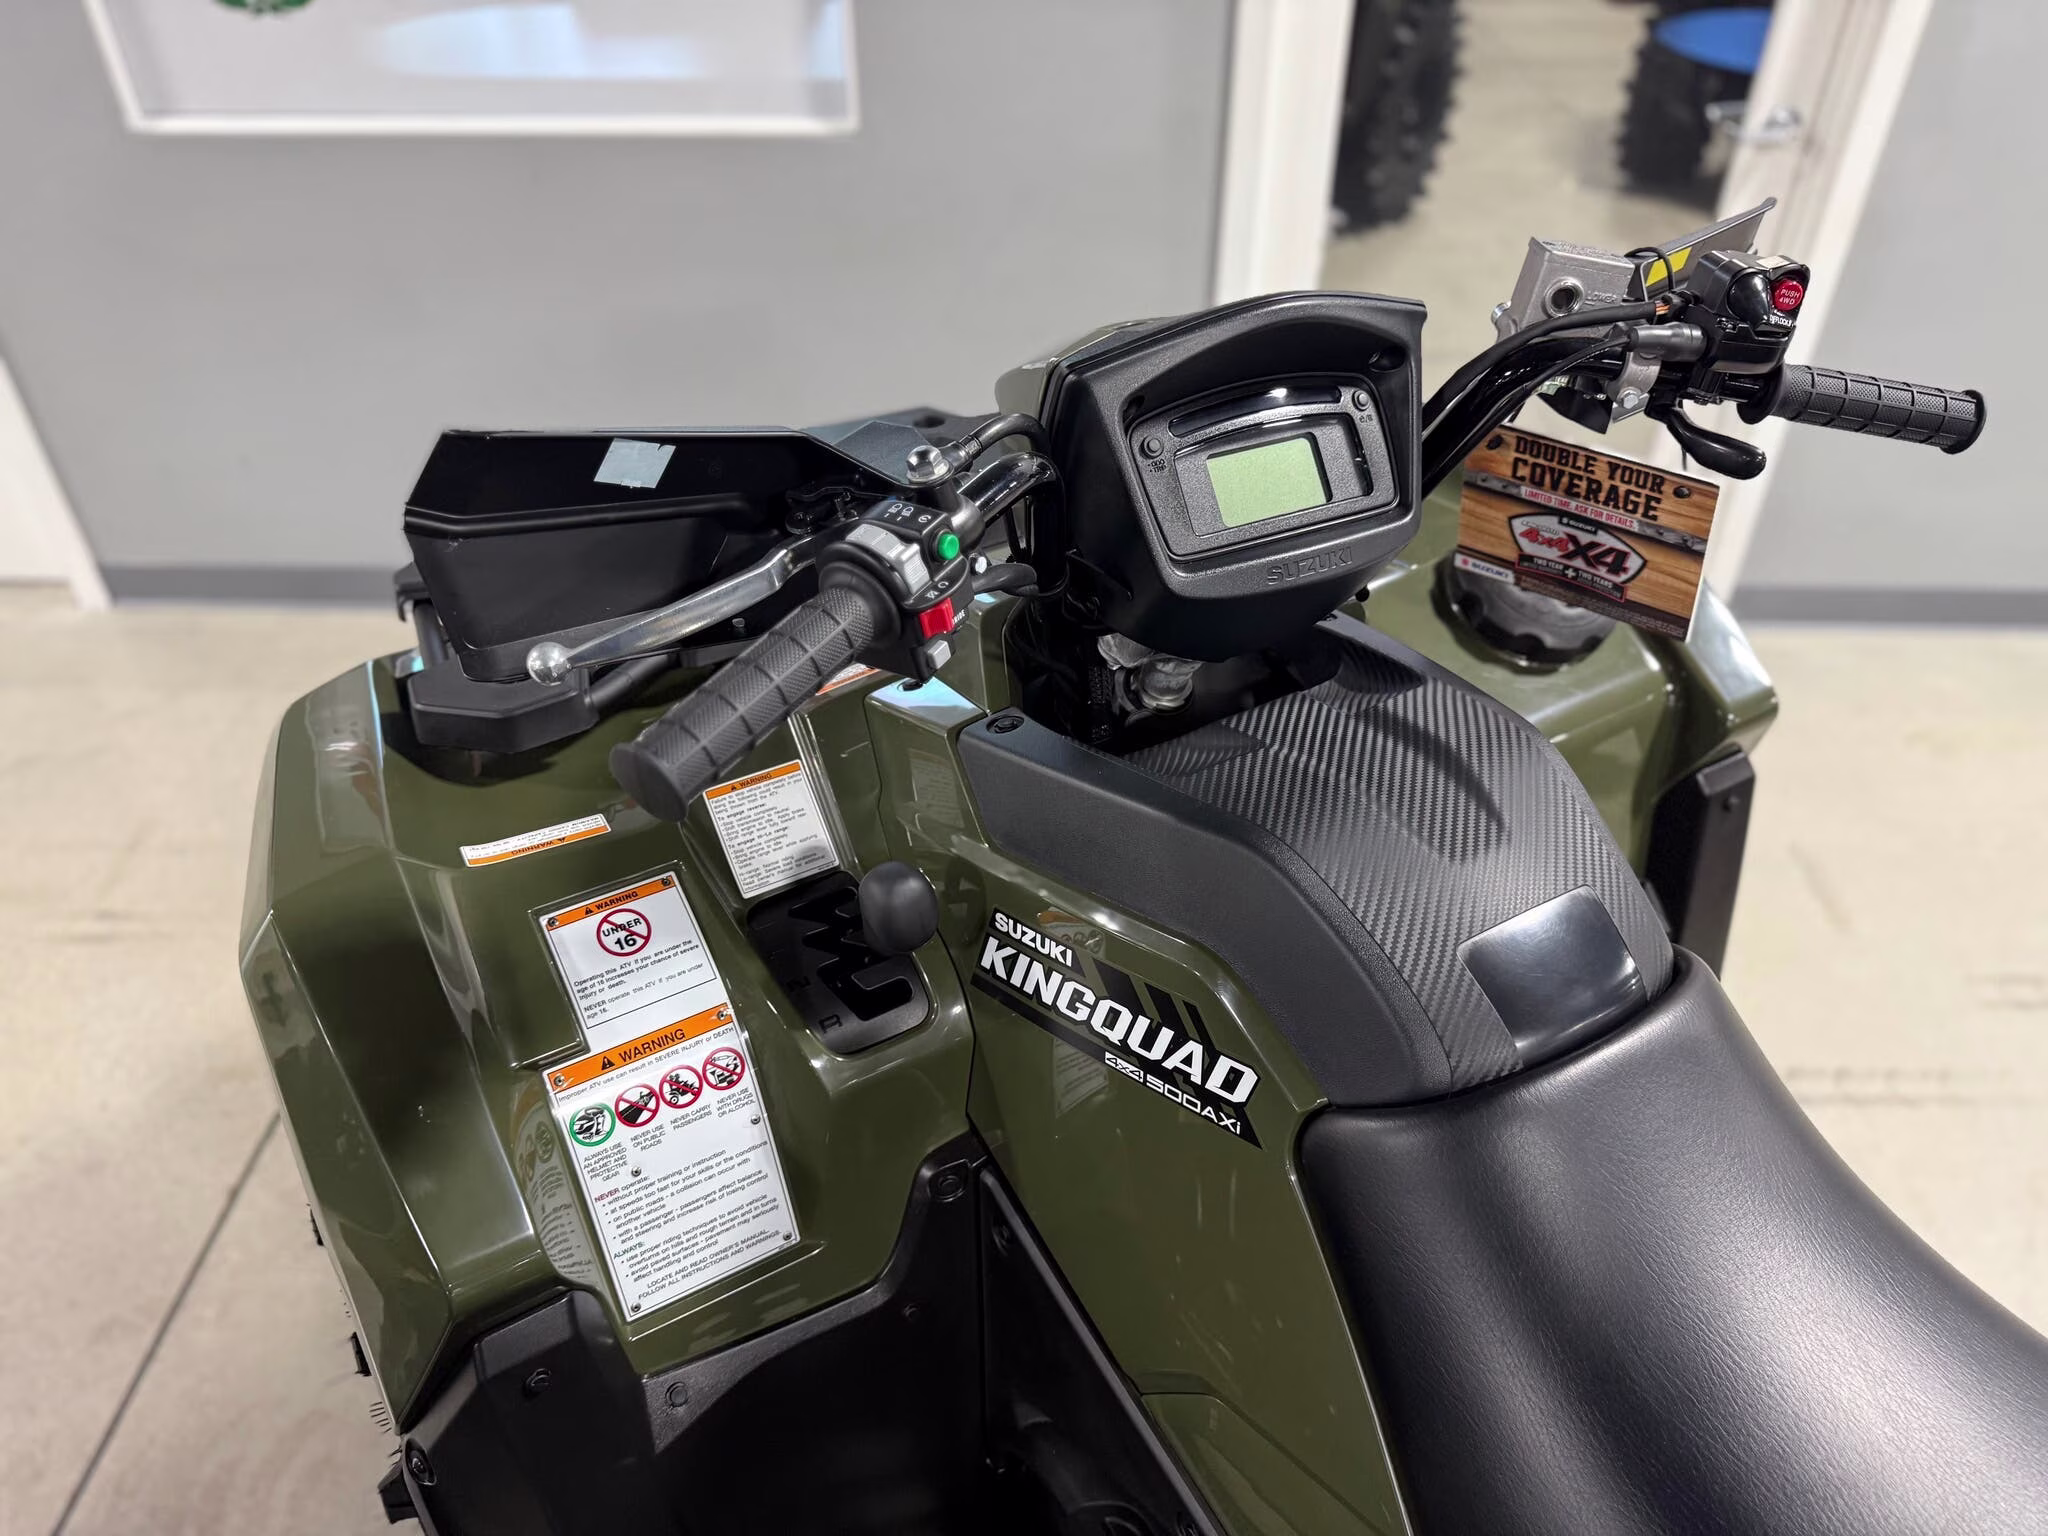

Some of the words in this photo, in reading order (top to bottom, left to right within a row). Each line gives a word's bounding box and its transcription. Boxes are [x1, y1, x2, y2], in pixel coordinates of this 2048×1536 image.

[1584, 290, 1618, 304] LOWER
[1779, 296, 1795, 305] 4WD
[1780, 289, 1801, 299] PUSH
[1513, 435, 1598, 475] DOUBLE
[1604, 460, 1666, 495] YOUR
[1509, 456, 1662, 521] COVERAGE
[1524, 489, 1552, 504] LIMITED
[1574, 504, 1589, 514] ASK
[1589, 508, 1604, 519] FOR
[1604, 513, 1636, 529] DETAILS.
[1267, 546, 1353, 585] SUZUKI
[1557, 531, 1632, 579] X4
[1470, 561, 1509, 579] SUZUKI
[1533, 556, 1547, 566] TWO
[1548, 560, 1563, 571] YEAR
[1577, 570, 1592, 580] TWO
[1592, 576, 1613, 588] YEARS
[739, 772, 772, 787] WARNING
[511, 840, 553, 856] WARNING
[595, 890, 638, 910] WARNING
[601, 917, 642, 937] UNDER
[613, 932, 638, 951] 16
[994, 912, 1073, 967] SUZUKI
[573, 971, 605, 988] Operating
[604, 966, 616, 975] this
[618, 961, 632, 969] ATV
[639, 955, 651, 963] you
[663, 942, 682, 952] under
[576, 986, 589, 995] age
[604, 967, 634, 982] increases
[635, 963, 649, 972] your
[649, 954, 671, 965] chance
[679, 944, 699, 954] severe
[583, 999, 606, 1012] NEVER
[607, 990, 631, 1004] operate
[632, 985, 643, 993] this
[644, 980, 656, 988] ATV
[665, 974, 676, 982] you
[686, 962, 703, 972] under
[607, 978, 626, 989] death.
[586, 1011, 598, 1020] age
[980, 936, 1259, 1103] KINGQUAD
[618, 1027, 685, 1063] WARNING
[558, 1086, 587, 1102] Improper
[588, 1080, 601, 1089] ATV
[602, 1076, 614, 1084] use
[615, 1070, 627, 1078] can
[628, 1062, 646, 1073] result
[654, 1048, 679, 1062] SEVERE
[680, 1038, 704, 1052] INJURY
[712, 1026, 733, 1038] DEATH
[716, 1092, 736, 1104] NEVER
[736, 1087, 749, 1096] USE
[716, 1101, 731, 1111] WITH
[731, 1092, 753, 1104] DRUGS
[1106, 1054, 1143, 1082] 4x4
[1146, 1074, 1241, 1135] 500AXi
[670, 1112, 690, 1124] NEVER
[690, 1103, 711, 1116] CARRY
[717, 1109, 727, 1118] OR
[727, 1097, 755, 1113] ALCOHOL
[672, 1109, 712, 1130] PASSENGERS
[630, 1129, 651, 1142] NEVER
[651, 1123, 664, 1133] USE
[632, 1139, 642, 1148] ON
[642, 1130, 665, 1143] PUBLIC
[582, 1147, 609, 1162] ALWAYS
[608, 1141, 622, 1151] USE
[639, 1138, 662, 1151] ROADS
[582, 1161, 592, 1169] AN
[592, 1146, 627, 1164] APPROVED
[586, 1160, 612, 1174] HELMET
[612, 1153, 627, 1163] AND
[589, 1160, 628, 1180] PROTECTIVE
[601, 1170, 620, 1181] GEAR
[607, 1190, 632, 1205] without
[633, 1181, 656, 1194] proper
[656, 1168, 682, 1184] training
[691, 1148, 726, 1168] instruction
[618, 1195, 643, 1210] speeds
[643, 1190, 656, 1198] too
[656, 1183, 670, 1192] fast
[670, 1178, 680, 1186] for
[681, 1172, 696, 1183] your
[696, 1163, 713, 1174] skills
[722, 1155, 734, 1163] the
[734, 1139, 767, 1158] conditions
[594, 1187, 619, 1202] NEVER
[620, 1174, 650, 1191] operate:
[622, 1204, 644, 1218] public
[644, 1195, 664, 1207] roads
[674, 1178, 702, 1194] collision
[703, 1172, 716, 1181] can
[716, 1164, 735, 1175] occur
[736, 1157, 750, 1167] with
[617, 1227, 632, 1237] with
[639, 1209, 674, 1228] passenger
[679, 1189, 717, 1210] passengers
[717, 1180, 736, 1192] affect
[736, 1169, 762, 1183] balance
[620, 1234, 633, 1244] and
[634, 1222, 662, 1238] steering
[662, 1215, 675, 1225] and
[676, 1202, 703, 1218] increase
[704, 1196, 716, 1205] risk
[725, 1183, 745, 1197] losing
[745, 1172, 768, 1186] control
[615, 1213, 642, 1229] another
[642, 1202, 666, 1217] vehicle
[612, 1240, 645, 1259] ALWAYS:
[646, 1272, 673, 1288] LOCATE
[673, 1265, 689, 1275] AND
[689, 1256, 708, 1268] READ
[707, 1241, 739, 1259] OWNER'S
[740, 1227, 769, 1244] MANUAL.
[637, 1282, 667, 1299] FOLLOW
[667, 1276, 680, 1286] ALL
[680, 1252, 730, 1279] INSTRUCTIONS
[729, 1245, 744, 1256] AND
